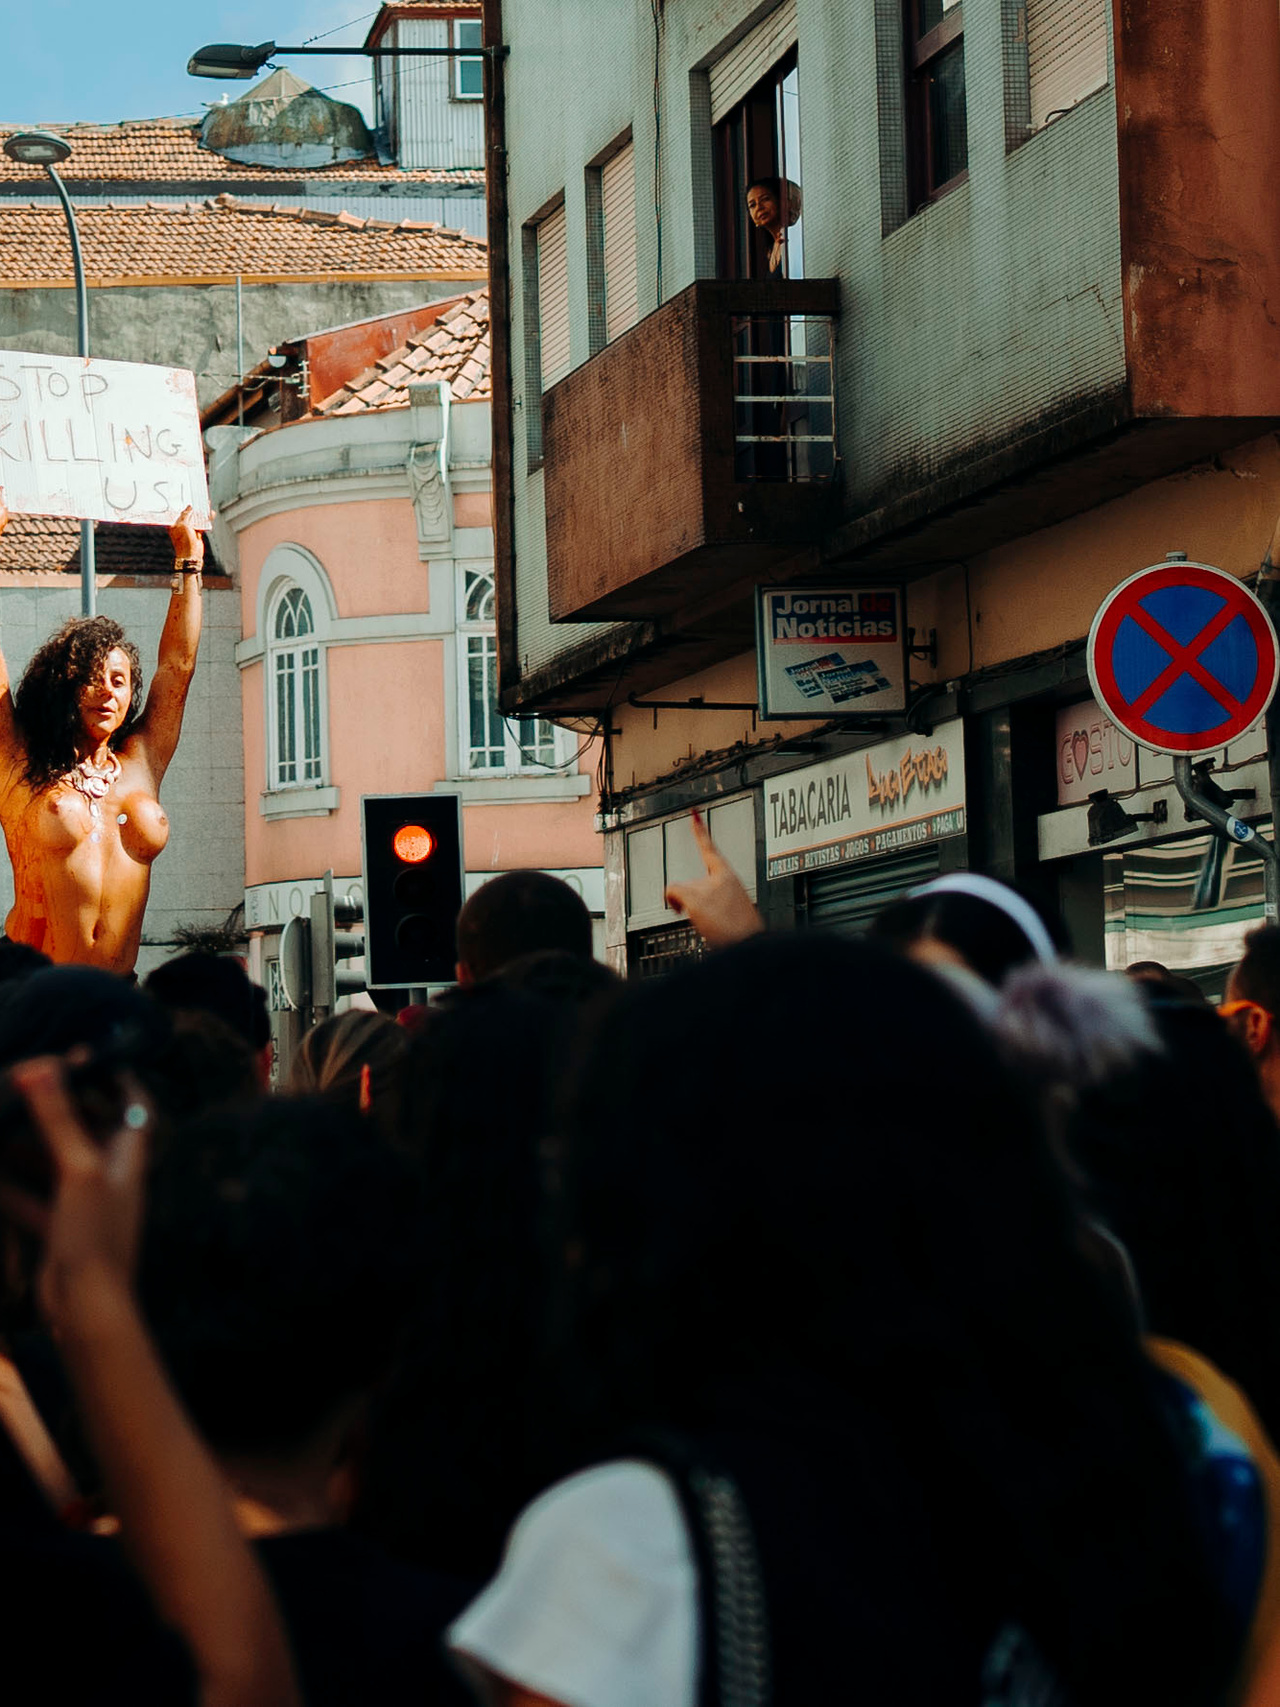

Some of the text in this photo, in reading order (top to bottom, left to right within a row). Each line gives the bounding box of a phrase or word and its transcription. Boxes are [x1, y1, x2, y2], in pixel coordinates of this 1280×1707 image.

[776, 592, 892, 615] Jornal de
[776, 615, 894, 639] Notícias
[770, 772, 851, 838] TABACARIA
[769, 856, 799, 877] JORNAIS
[804, 846, 840, 868] REVISTAS
[845, 837, 870, 859] JOGOS
[875, 821, 928, 851] PAGAMENTOS
